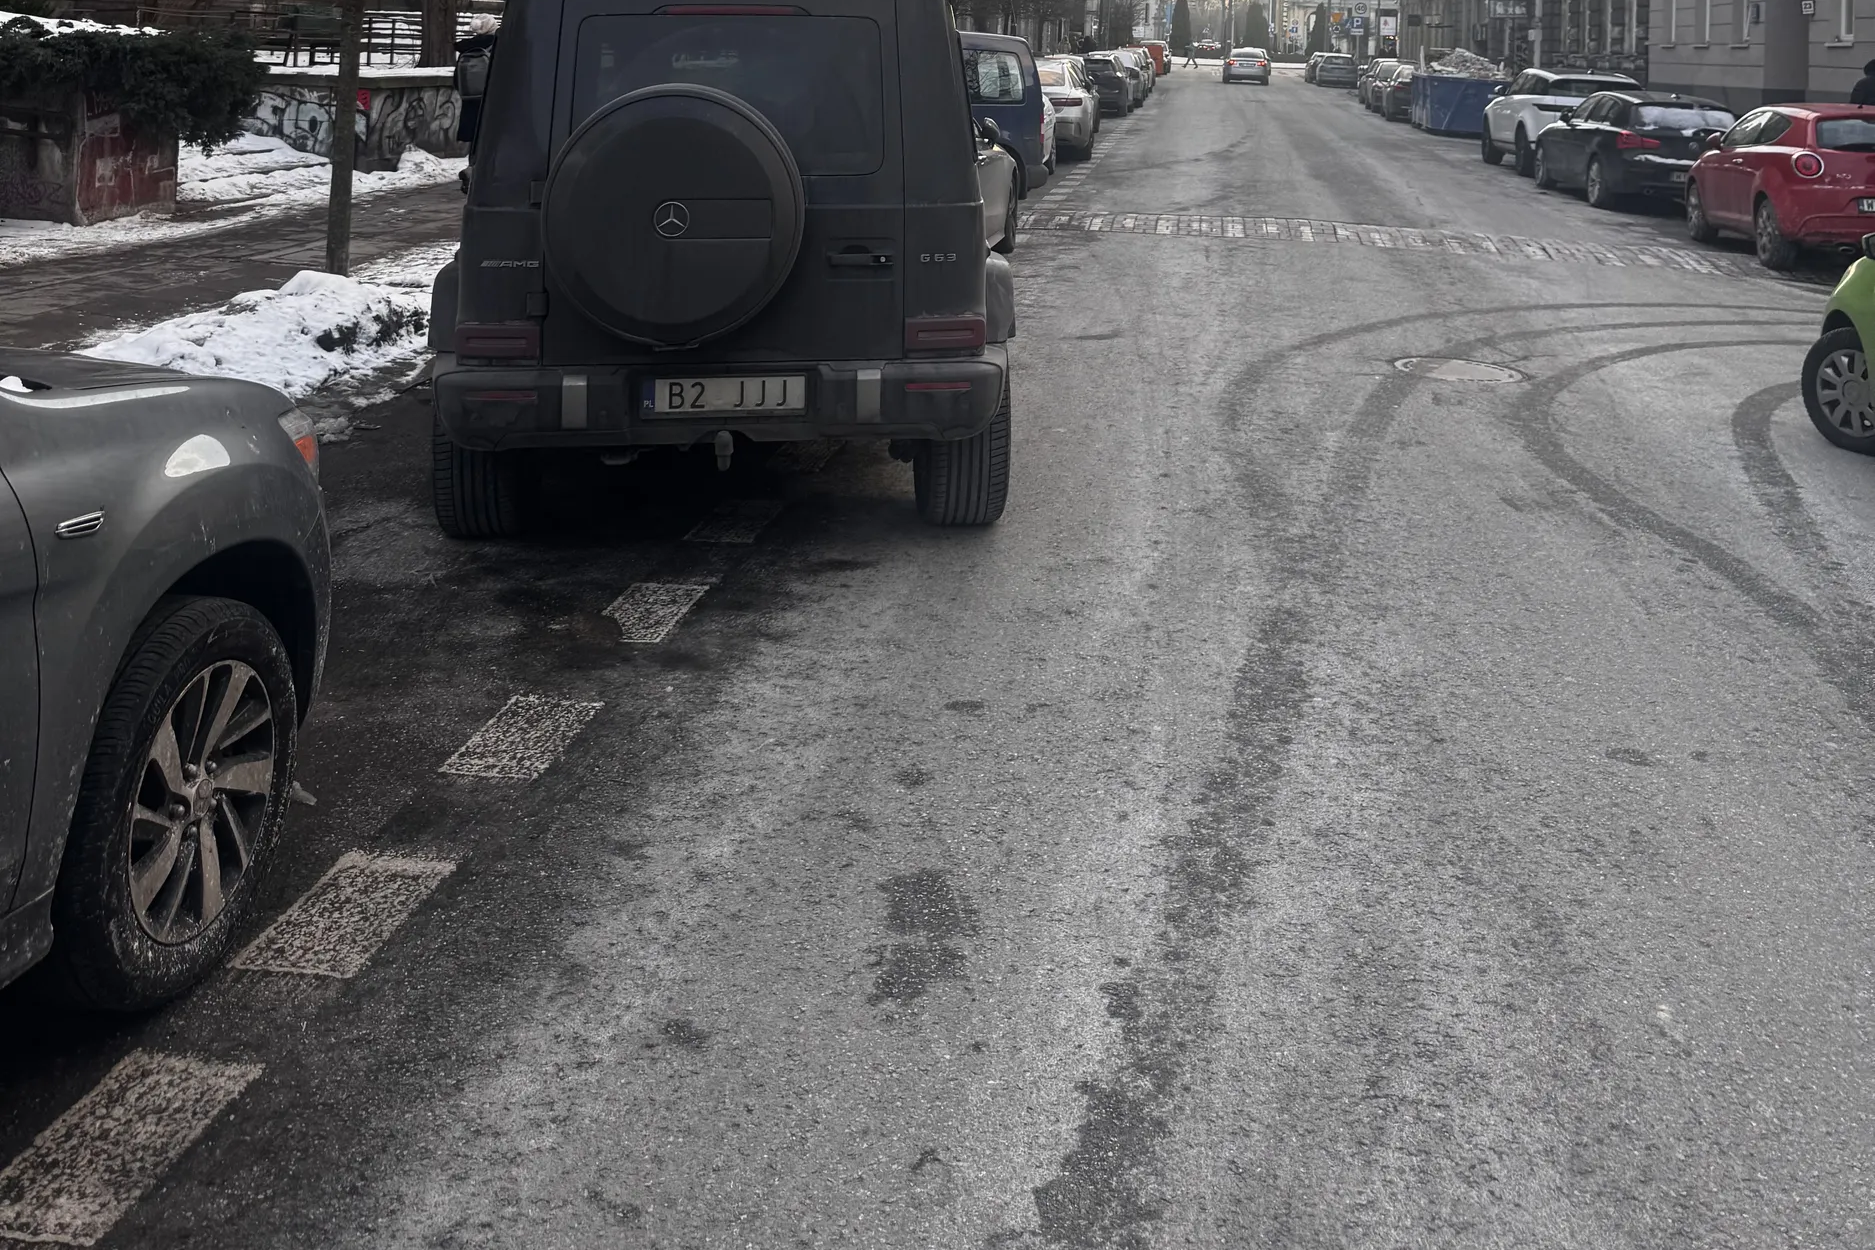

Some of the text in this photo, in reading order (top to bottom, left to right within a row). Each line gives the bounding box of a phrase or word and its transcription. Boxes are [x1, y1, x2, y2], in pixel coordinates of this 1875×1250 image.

[1353, 17, 1362, 28] P
[920, 253, 957, 263] G 63
[499, 260, 539, 268] AMG
[668, 379, 788, 410] B2 JJJ
[643, 400, 654, 408] PL
